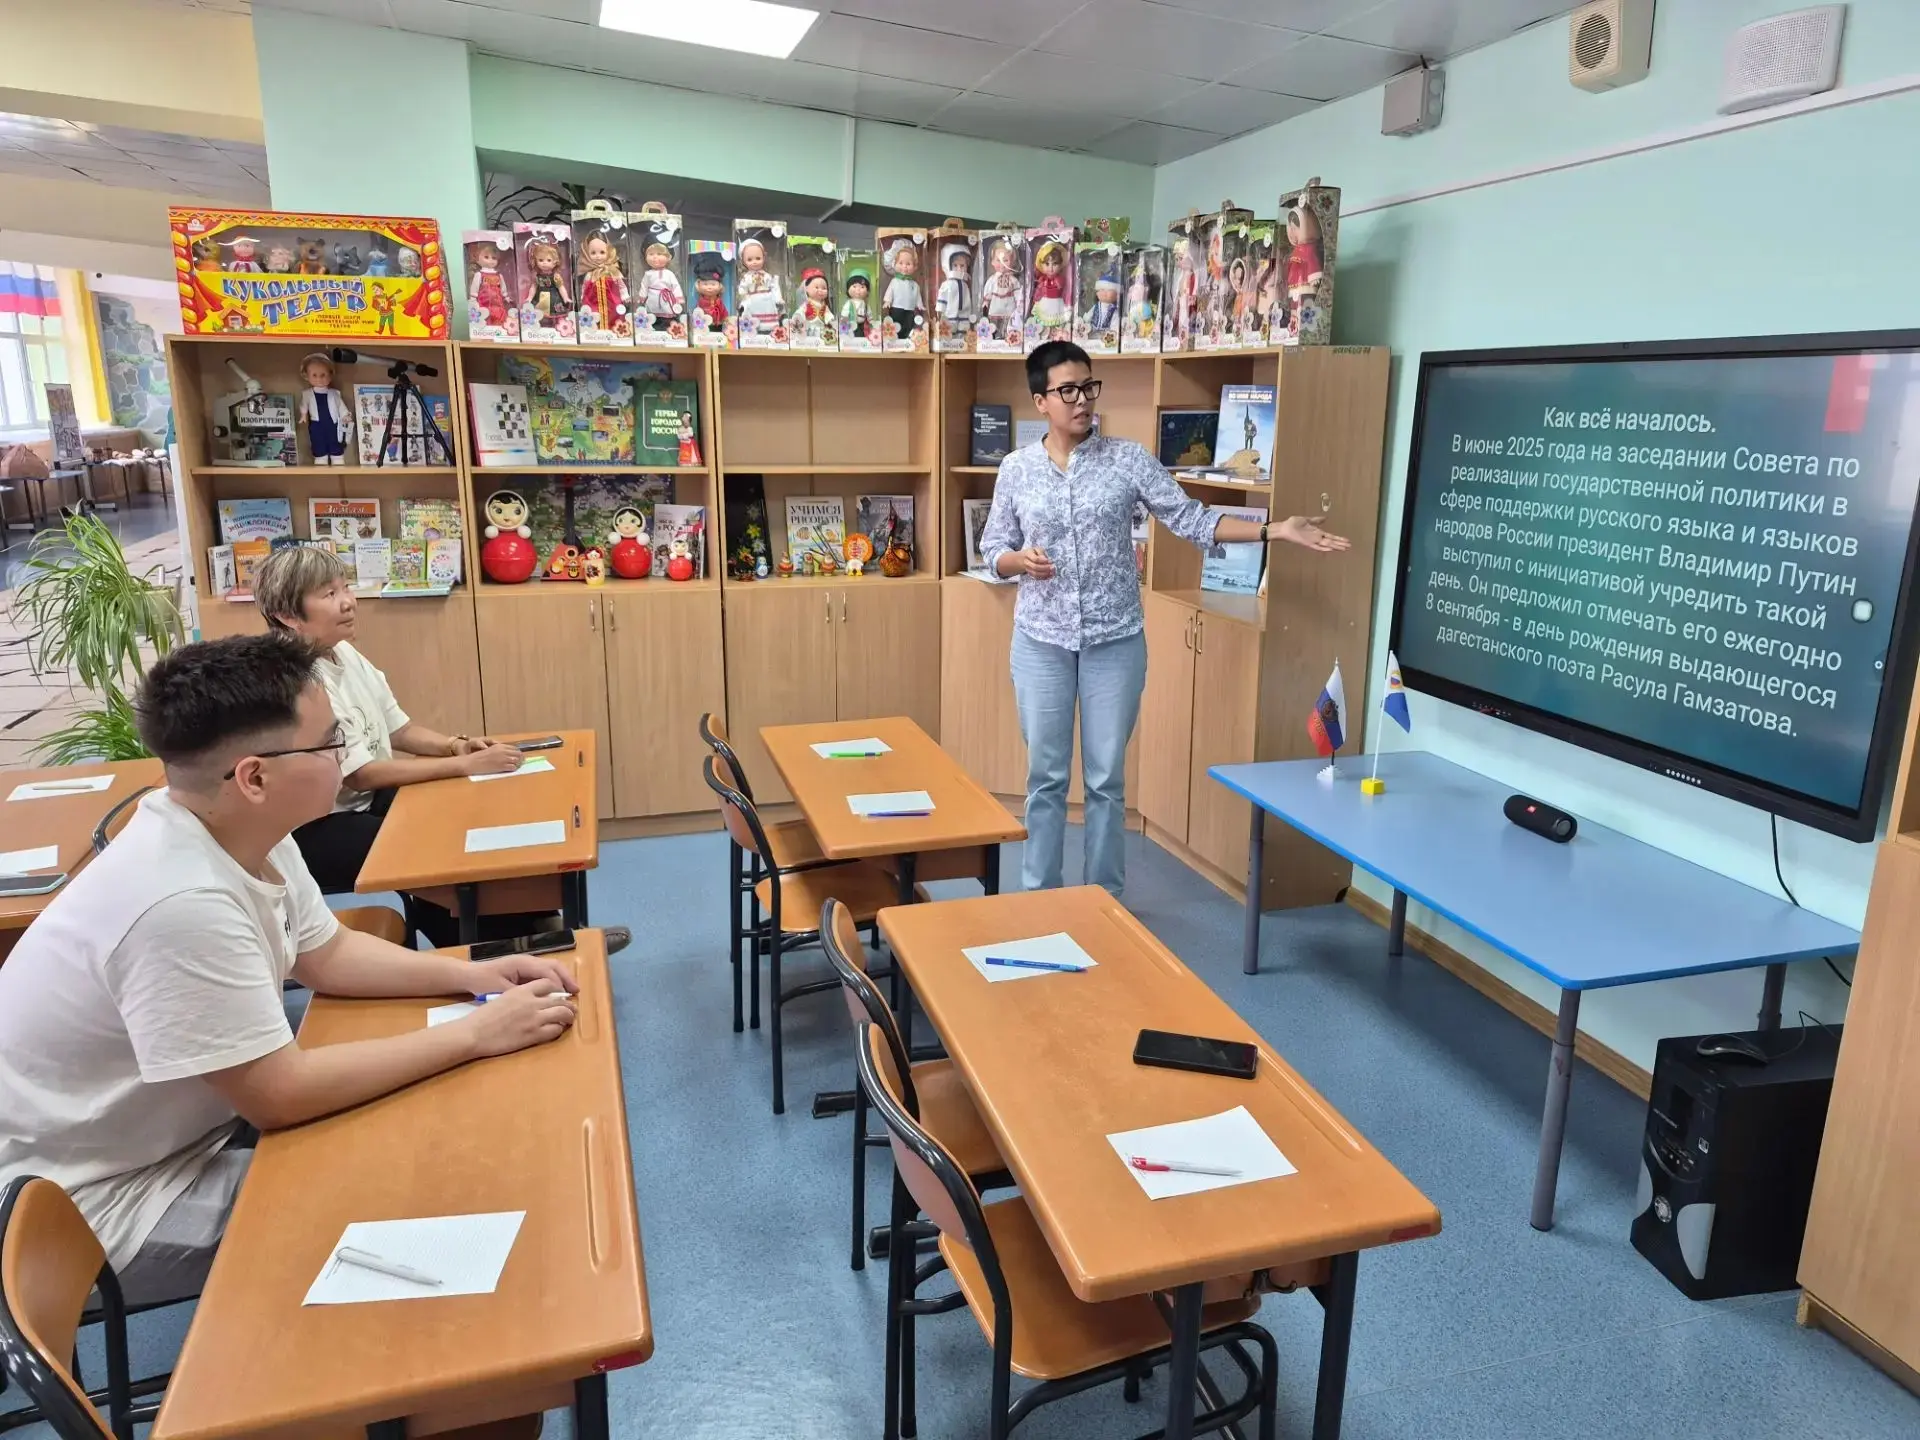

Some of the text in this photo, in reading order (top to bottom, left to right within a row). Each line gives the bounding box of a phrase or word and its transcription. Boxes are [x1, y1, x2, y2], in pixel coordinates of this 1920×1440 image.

[222, 277, 365, 303] КУКОЛЬНЫЙ
[262, 291, 367, 327] ТЕАТР
[240, 416, 290, 424] ИЗОБРЕТЕНИЯ
[1544, 407, 1716, 433] Как всё началось.
[1452, 434, 1859, 478] В июне 2025 года на заседании Совета по
[790, 505, 841, 514] УЧИМСЯ
[1450, 466, 1848, 516] реализации государственной политики в
[791, 516, 842, 524] РИСОВАТЬ
[1440, 488, 1858, 557] сфере поддержки русского языка и языков
[1435, 518, 1856, 596] народов России президент Владимир Путин
[1443, 547, 1827, 630] выступил с инициативой учредить такой
[1428, 571, 1842, 671] день. Он предложил отмечать его ежегодно
[1426, 592, 1434, 610] 8
[1437, 599, 1500, 628] сентября
[1513, 616, 1522, 631] в
[1524, 620, 1564, 642] день
[1569, 630, 1663, 666] рождения
[1669, 652, 1837, 709] выдающегося
[1436, 626, 1797, 737] дагестанского поэта Расула Гамзатова.
